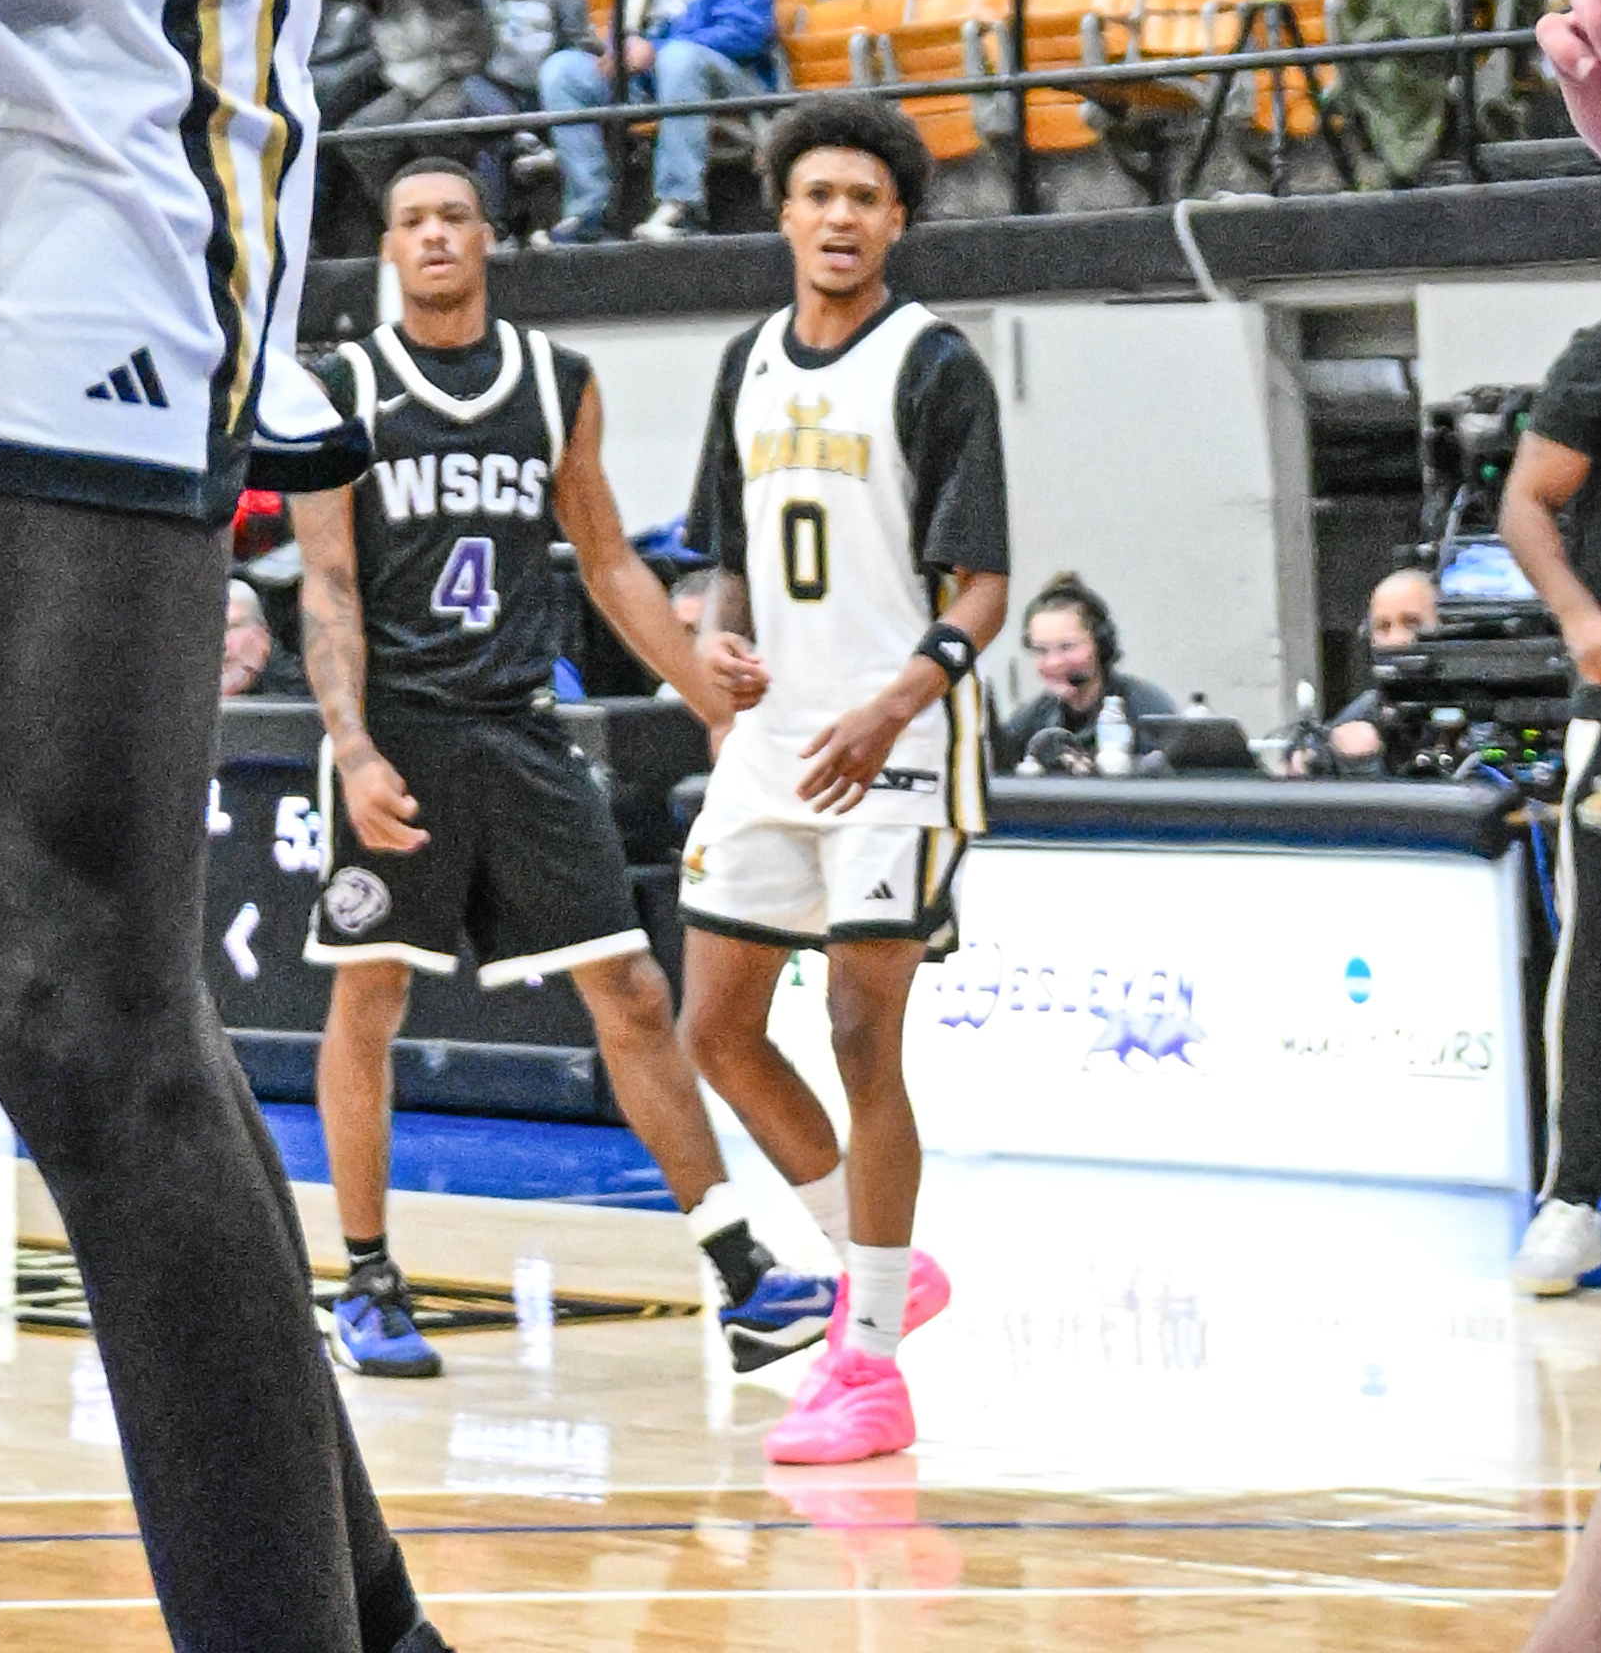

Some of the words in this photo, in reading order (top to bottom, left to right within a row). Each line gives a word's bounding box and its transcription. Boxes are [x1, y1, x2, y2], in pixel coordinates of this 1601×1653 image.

[373, 452, 549, 523] WSCS
[431, 536, 501, 631] 4
[780, 496, 828, 602] 0
